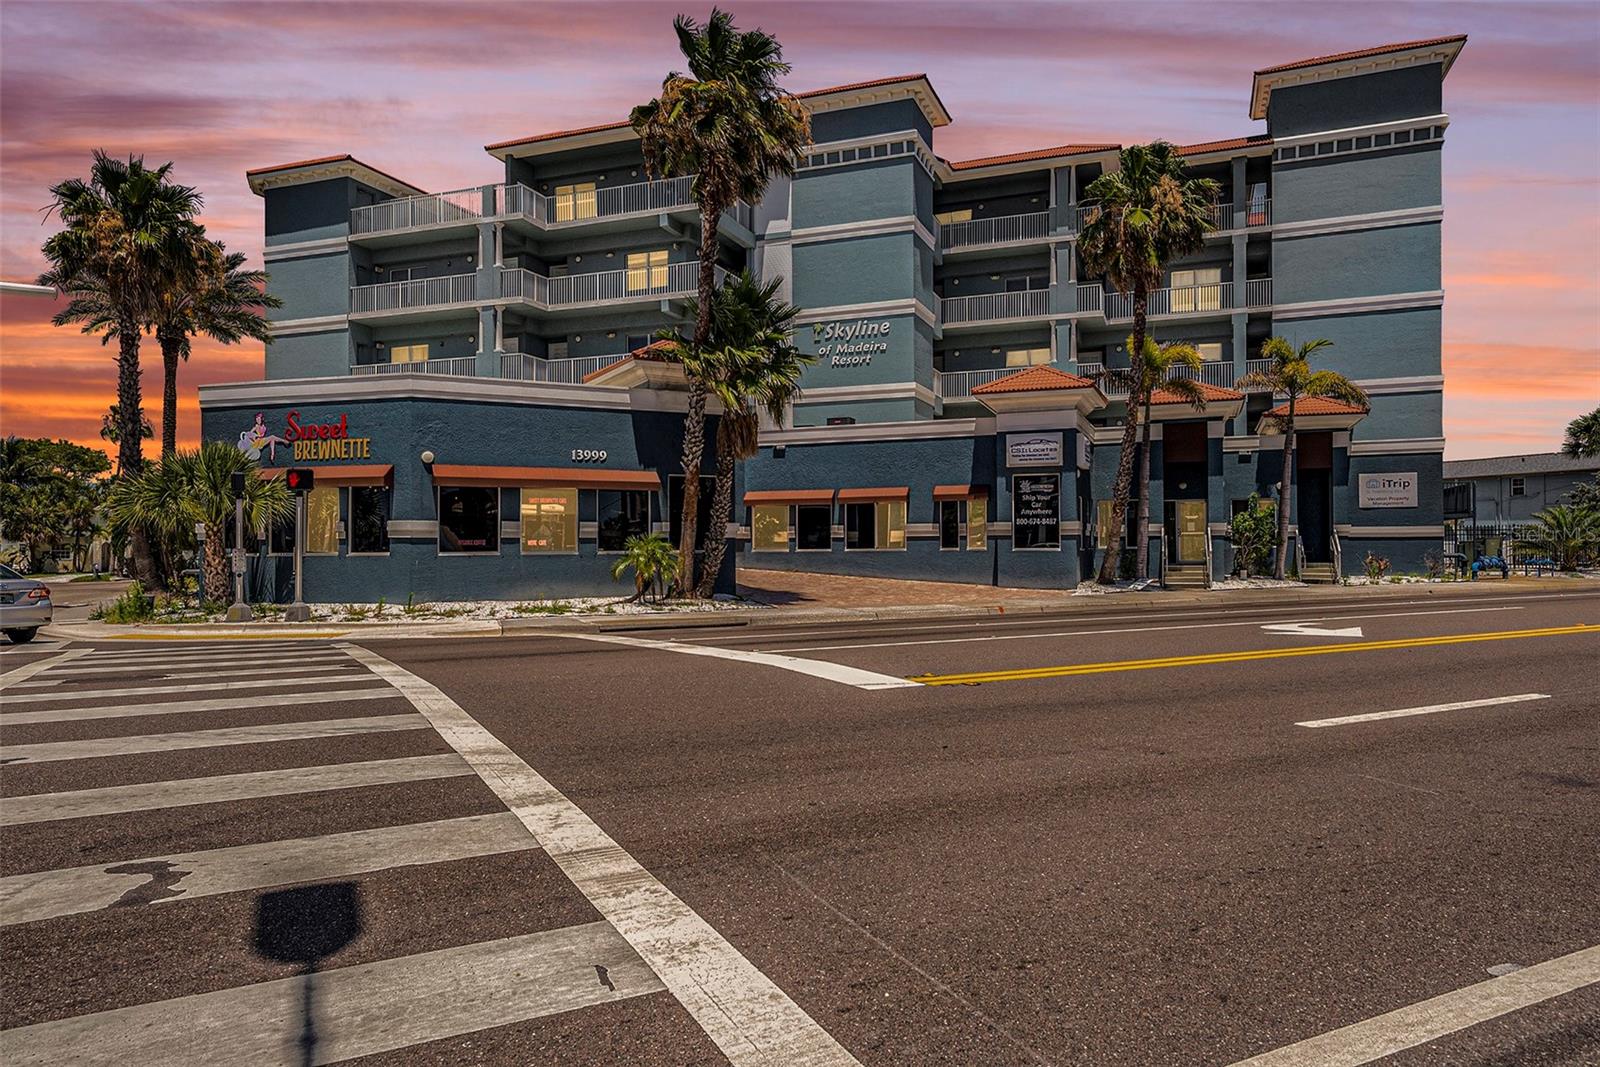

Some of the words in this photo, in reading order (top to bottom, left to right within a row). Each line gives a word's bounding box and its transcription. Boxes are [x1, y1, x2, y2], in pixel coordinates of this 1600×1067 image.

[824, 320, 890, 341] Skyline
[818, 344, 832, 355] of
[836, 341, 887, 353] Madeira
[831, 354, 872, 365] Resort
[285, 409, 348, 441] Sweet
[293, 437, 371, 460] BREWNETTE
[571, 449, 608, 461] 13999
[1382, 478, 1410, 490] iTrip
[1020, 508, 1053, 516] Anywhere
